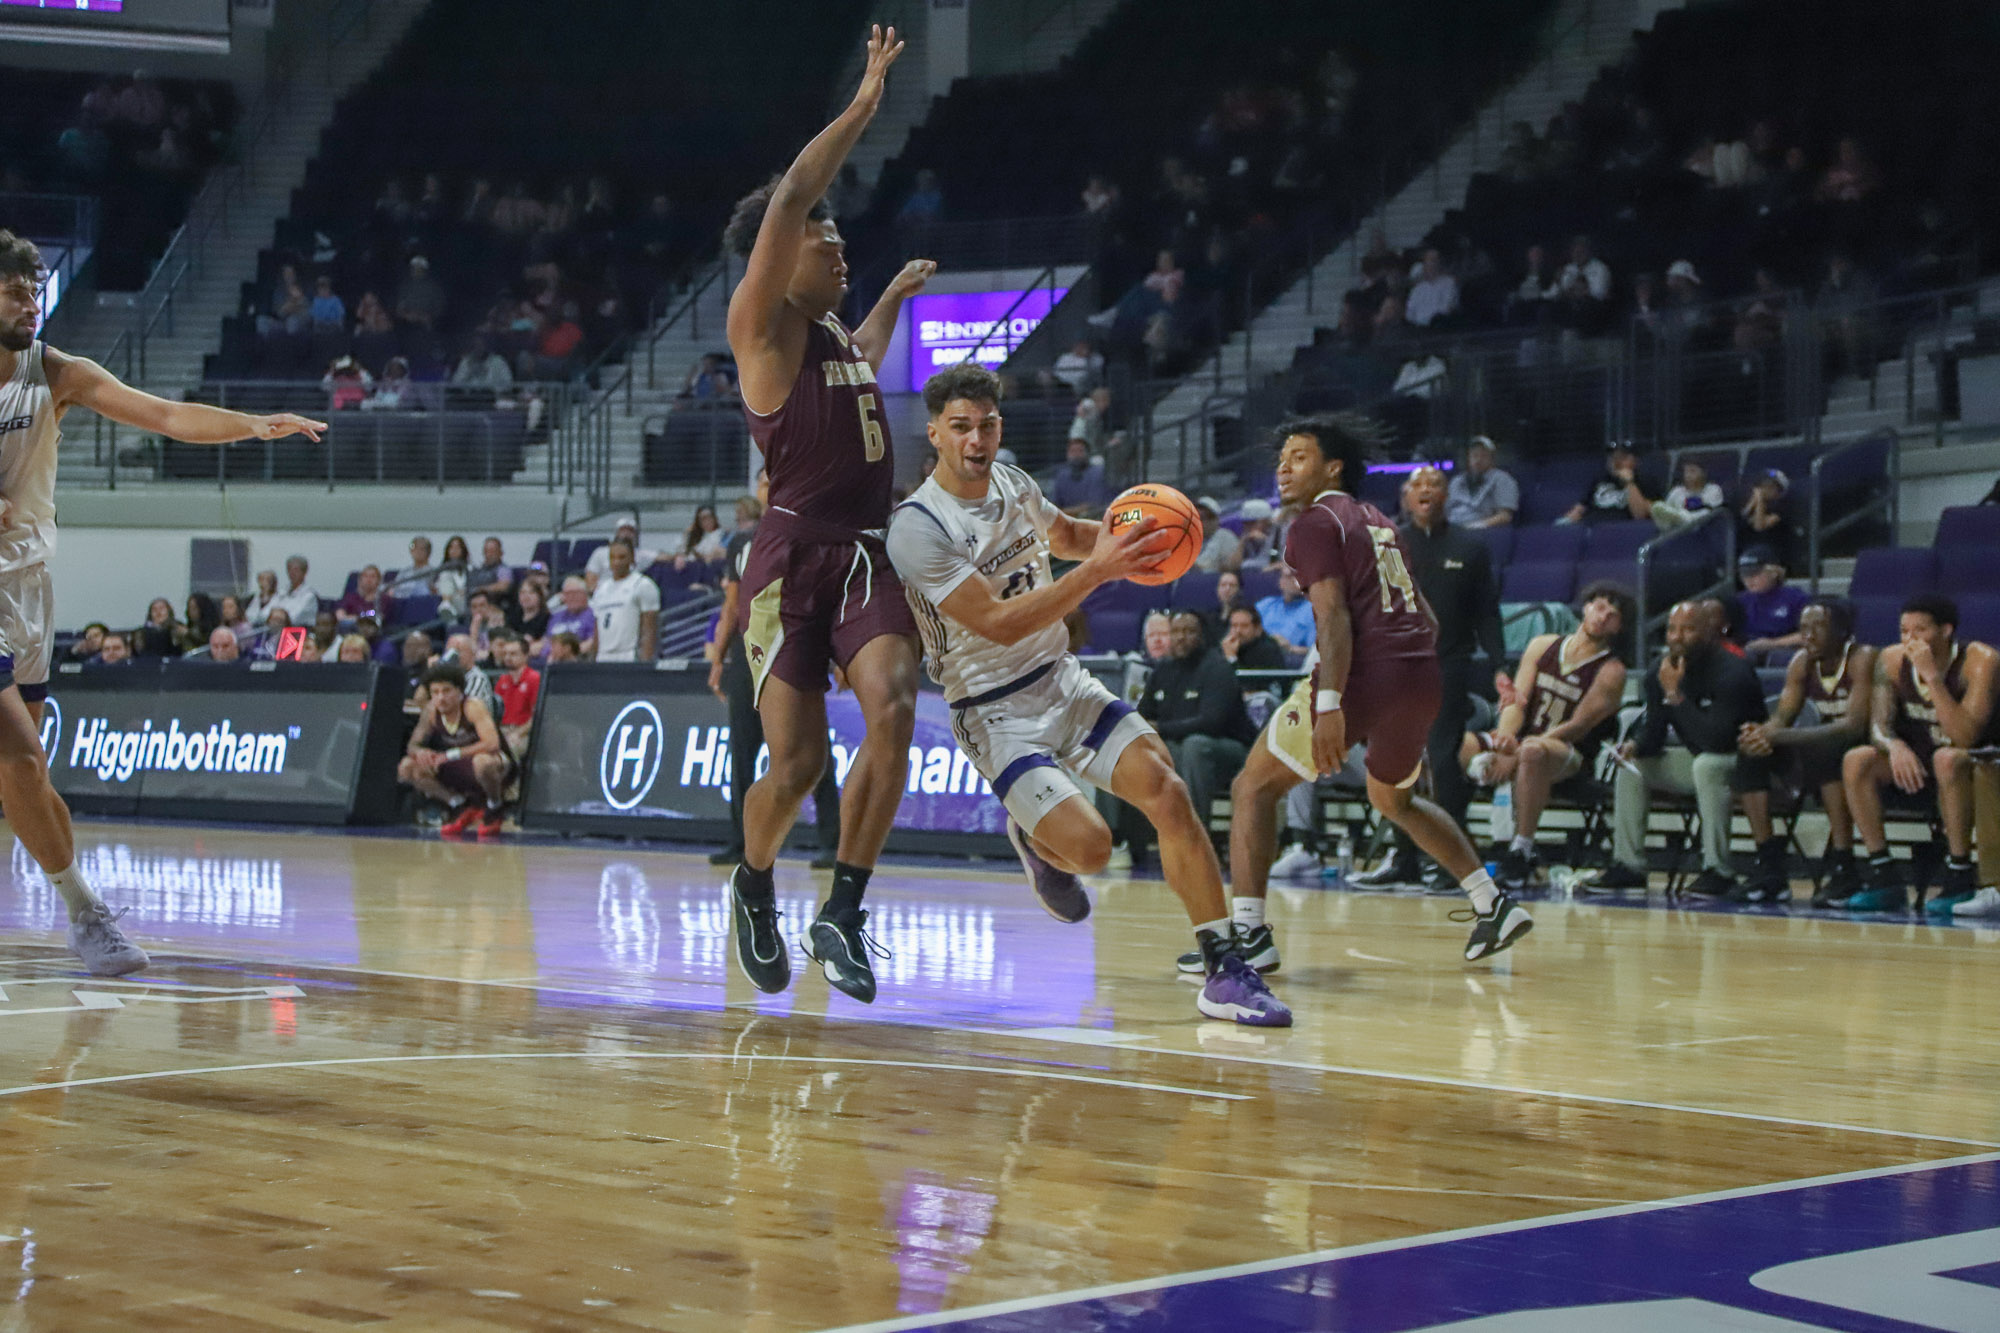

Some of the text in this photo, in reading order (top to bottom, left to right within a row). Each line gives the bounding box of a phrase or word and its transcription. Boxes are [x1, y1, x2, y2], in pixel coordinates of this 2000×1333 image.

[858, 393, 885, 462] 6
[1376, 544, 1418, 613] 14
[70, 717, 287, 781] Higginbotham
